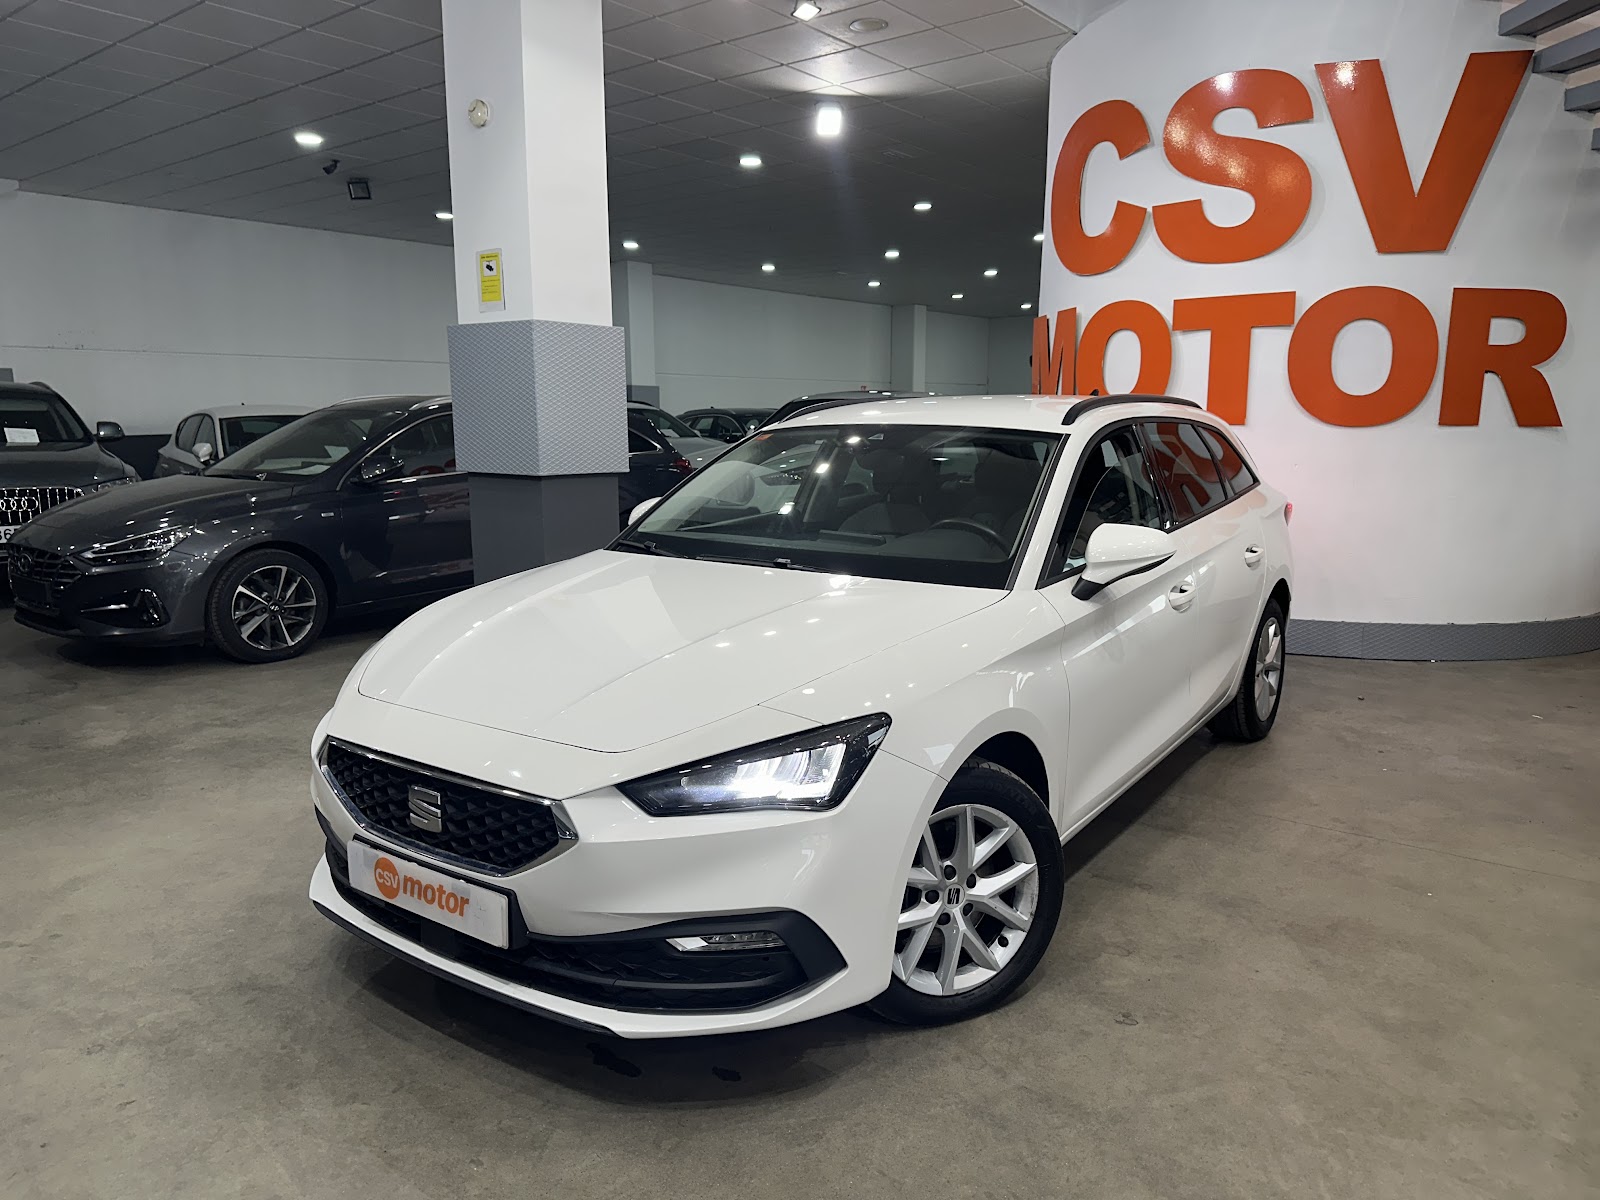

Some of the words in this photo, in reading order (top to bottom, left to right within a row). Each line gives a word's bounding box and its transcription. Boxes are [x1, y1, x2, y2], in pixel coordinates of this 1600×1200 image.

[1051, 50, 1534, 276] CSV
[1031, 285, 1568, 428] MOTOR
[375, 868, 399, 889] CSV
[402, 874, 470, 917] motor
